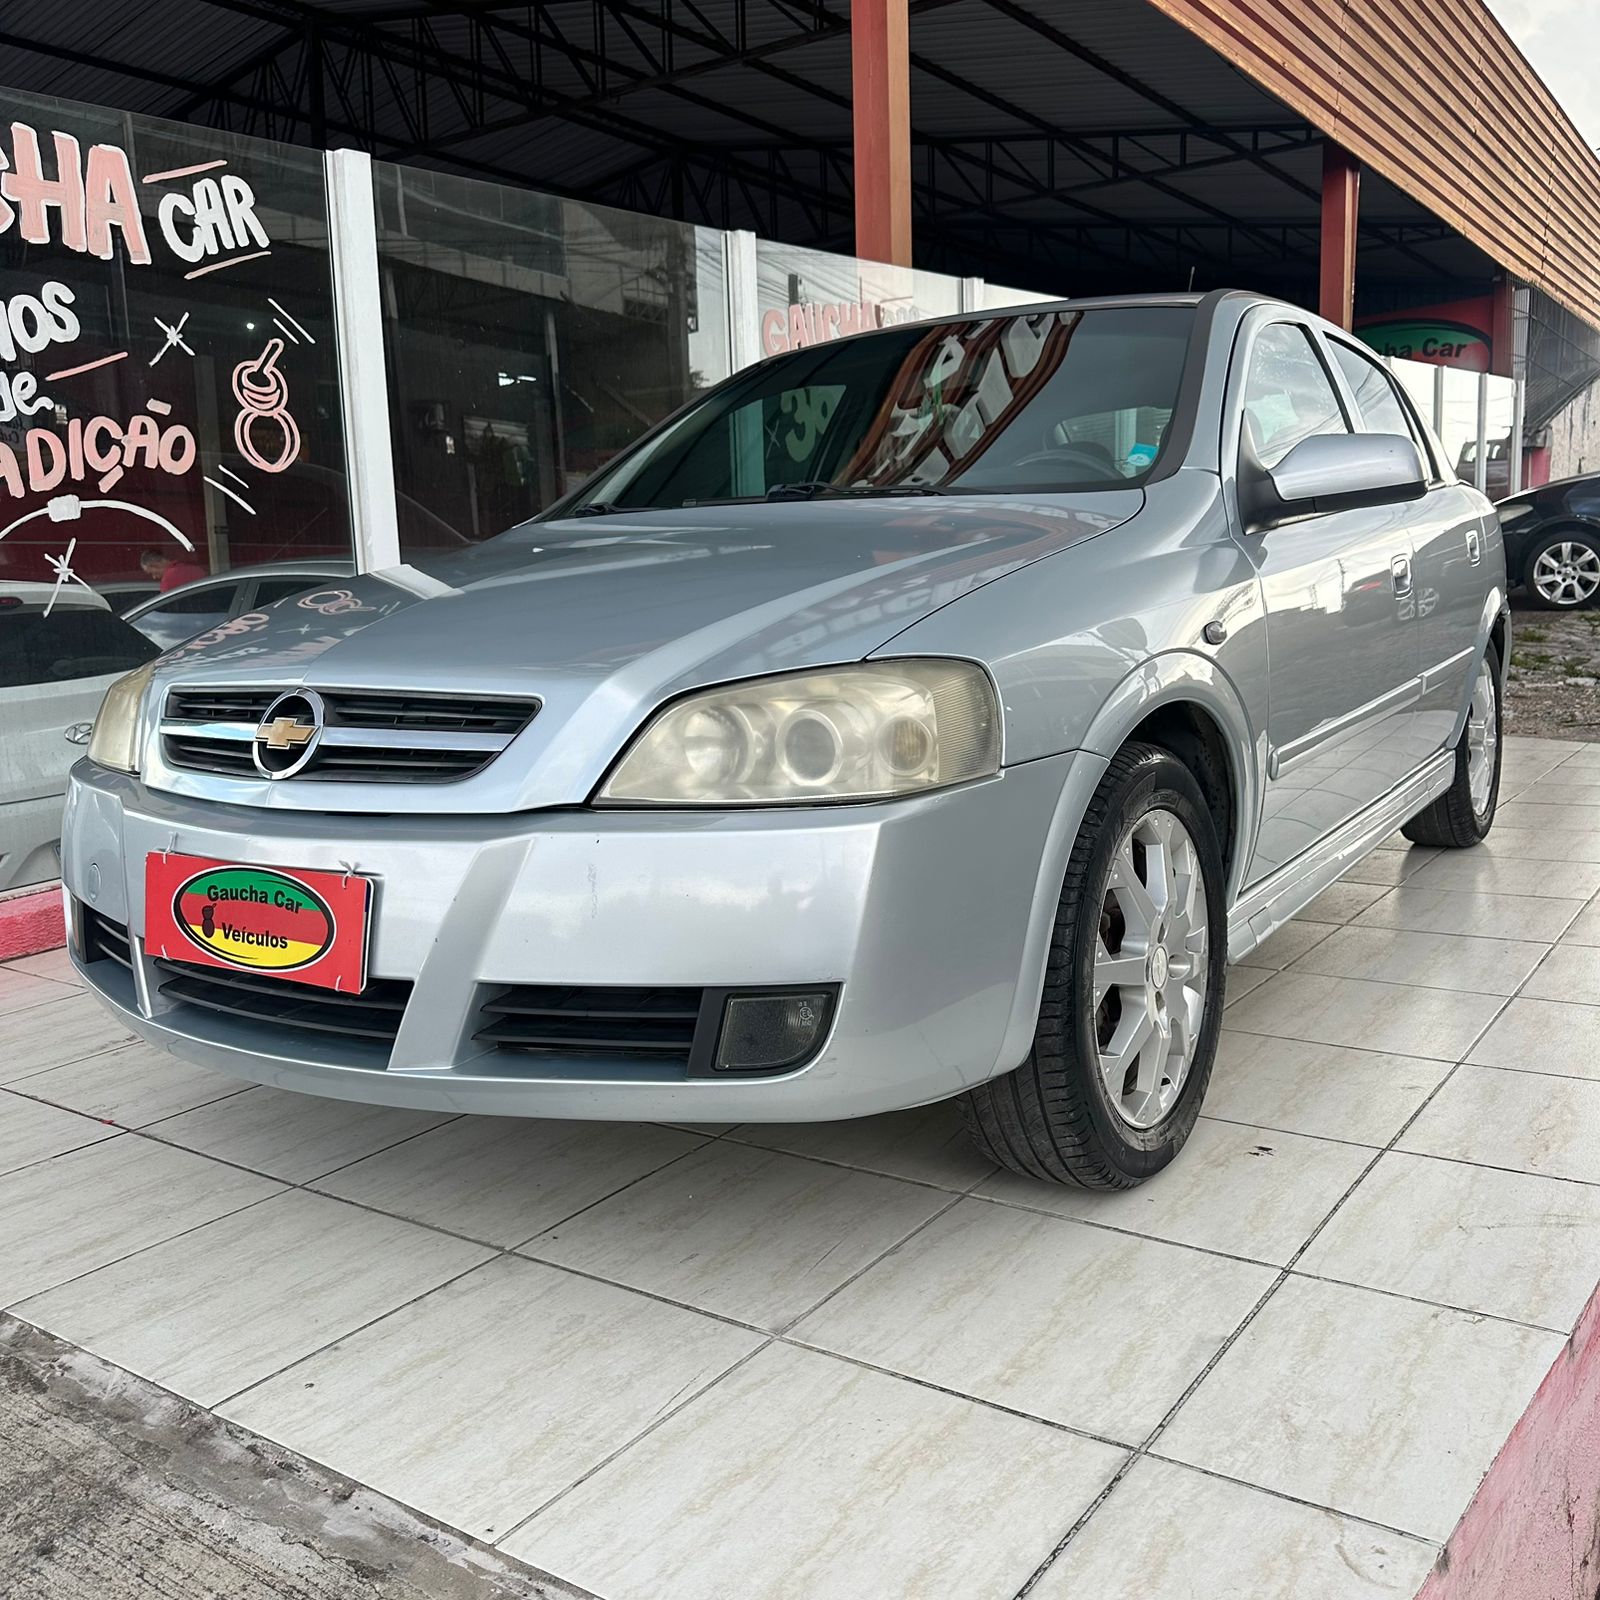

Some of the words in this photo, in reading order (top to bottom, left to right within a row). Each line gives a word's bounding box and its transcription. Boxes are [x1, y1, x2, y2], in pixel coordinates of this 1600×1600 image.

[157, 174, 270, 263] CAR
[1422, 337, 1468, 358] Car
[207, 884, 269, 905] Gaucha
[274, 889, 303, 914] Car
[221, 922, 288, 950] Veículos
